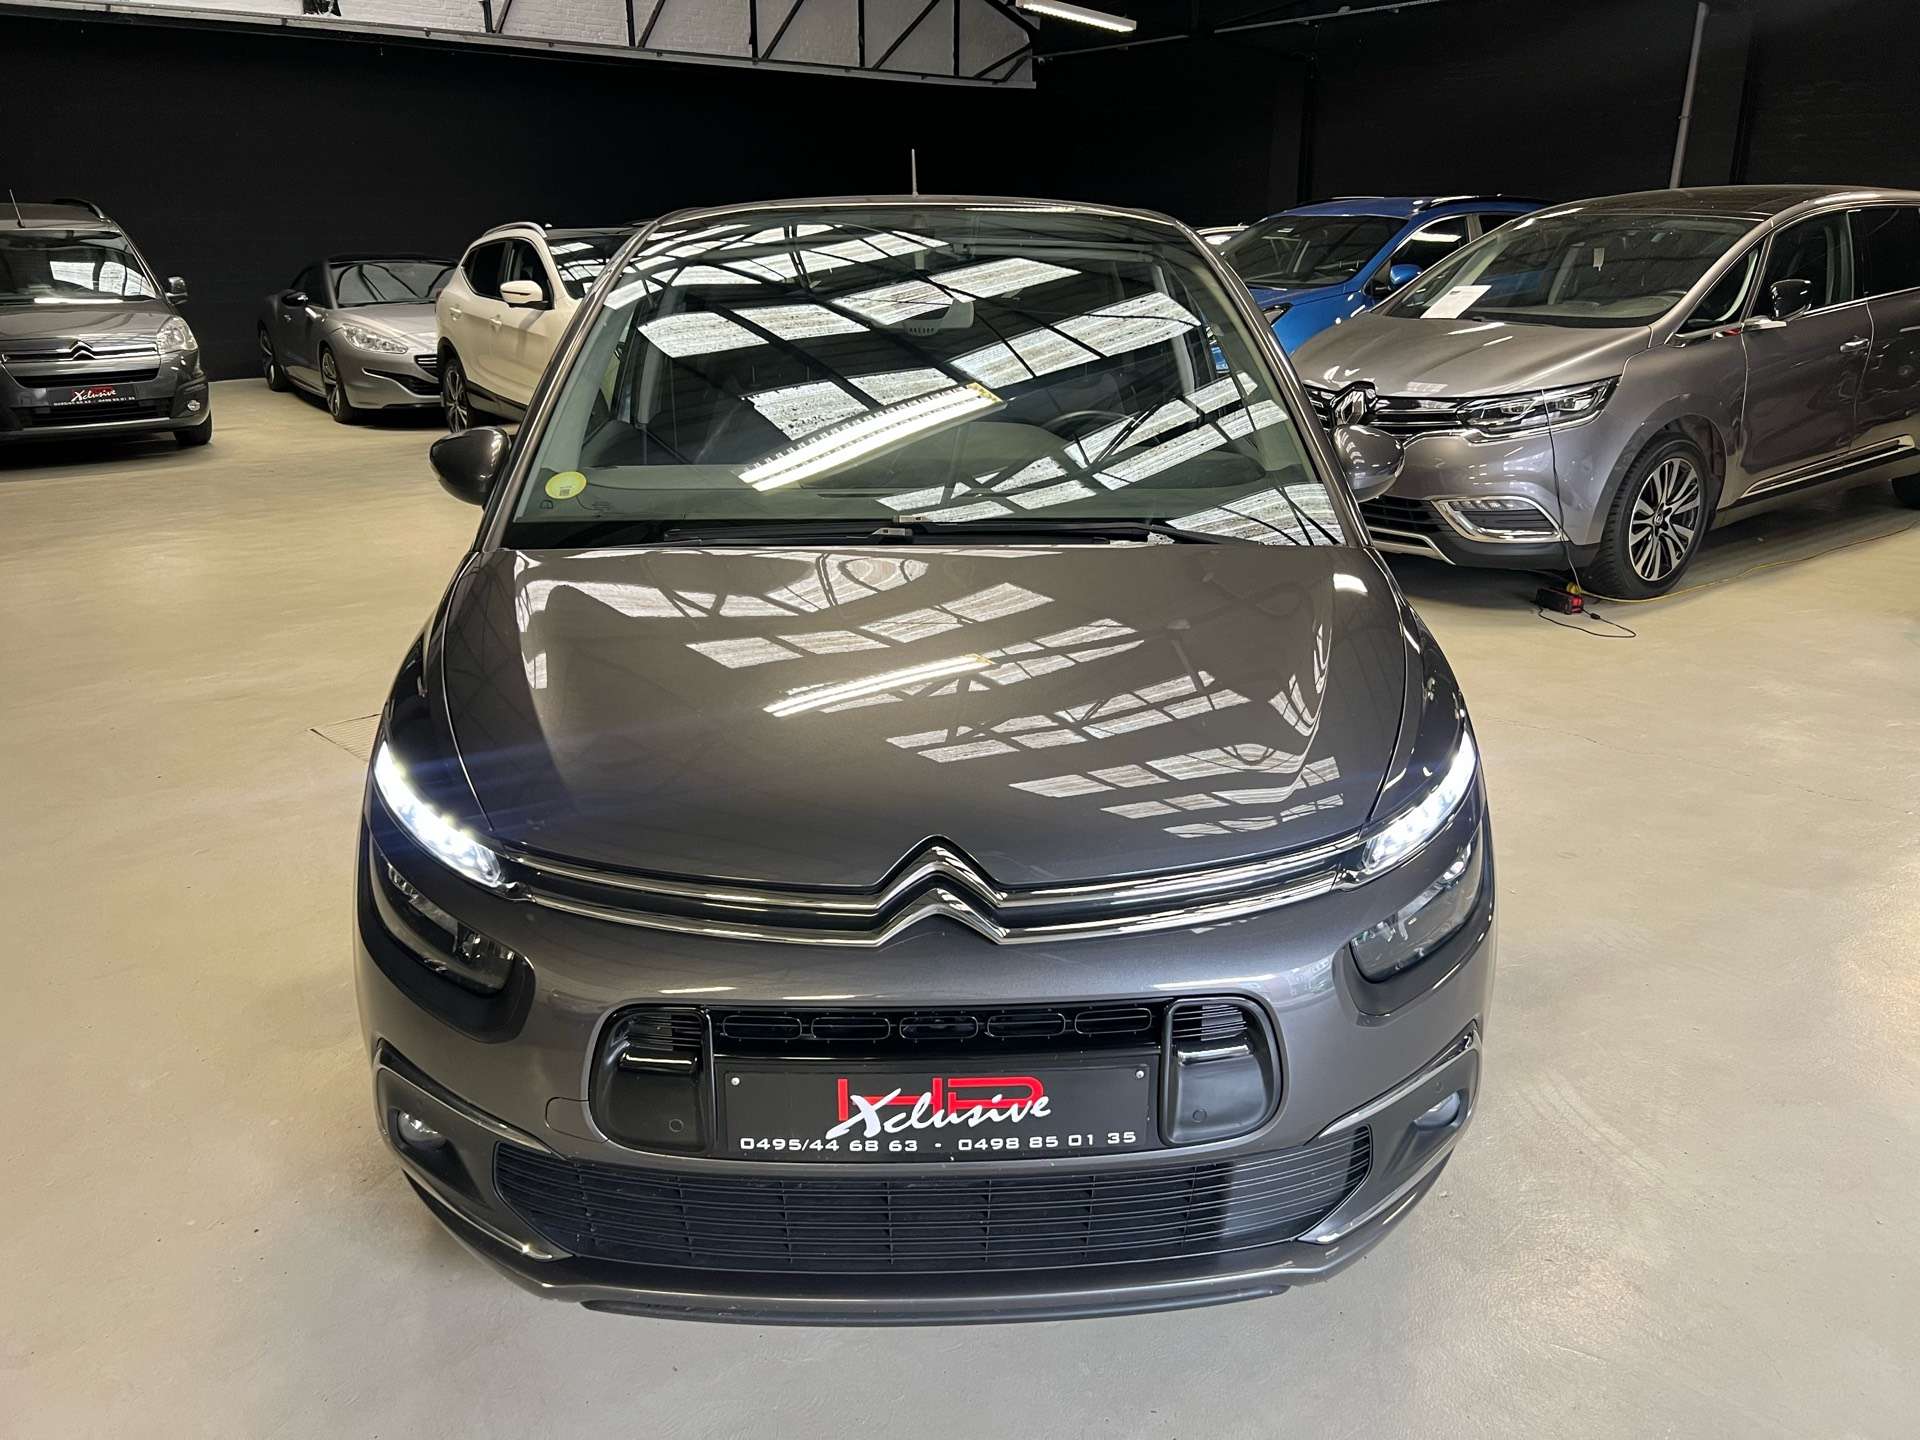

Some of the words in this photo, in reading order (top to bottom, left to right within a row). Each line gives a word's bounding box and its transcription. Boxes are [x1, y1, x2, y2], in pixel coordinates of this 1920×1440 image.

[71, 390, 116, 401] Xclusive
[825, 1088, 1051, 1139] Xclusive
[740, 1137, 840, 1151] 0495/44
[849, 1139, 879, 1152] 68
[888, 1139, 918, 1152] 63
[958, 1137, 1020, 1150] 0498
[1029, 1135, 1059, 1148] 85
[1068, 1134, 1094, 1146] 01
[1107, 1131, 1136, 1144] 35
